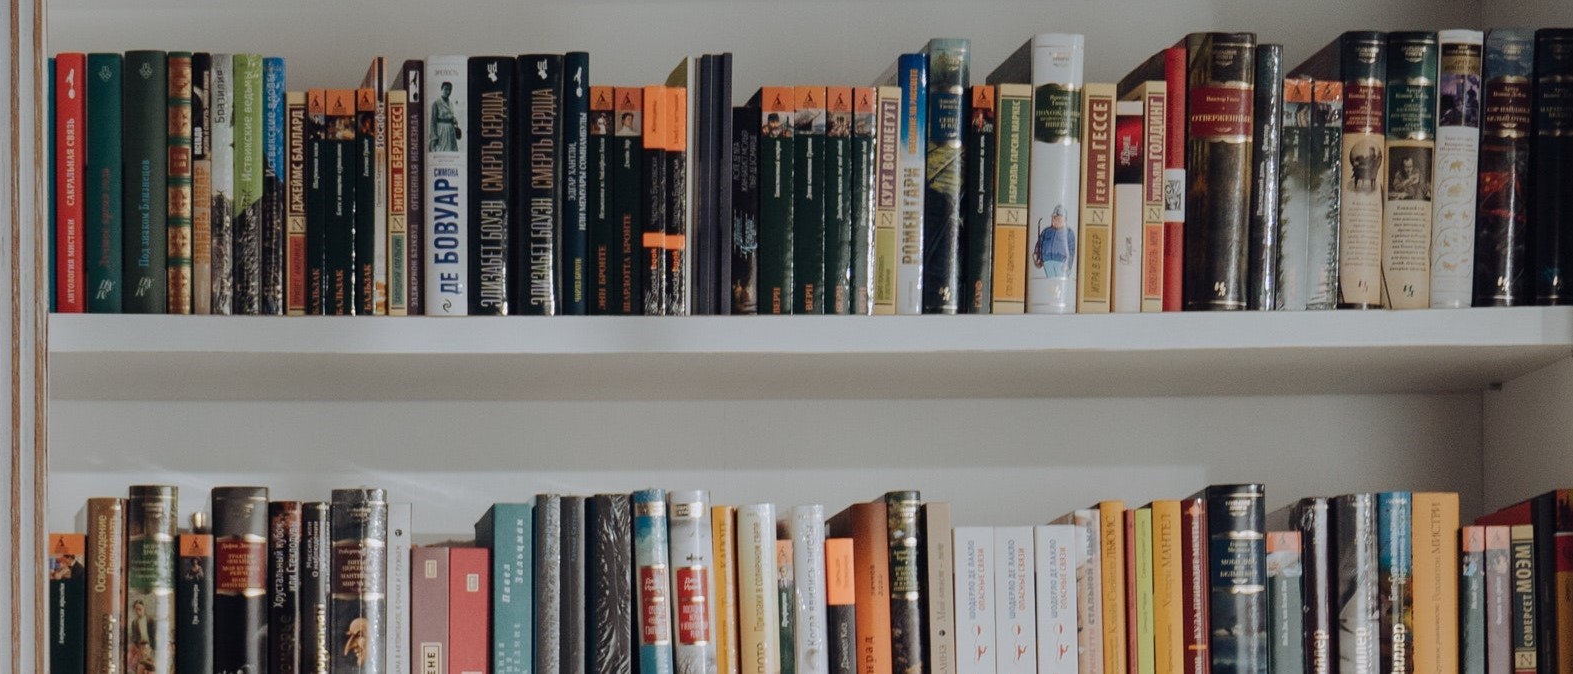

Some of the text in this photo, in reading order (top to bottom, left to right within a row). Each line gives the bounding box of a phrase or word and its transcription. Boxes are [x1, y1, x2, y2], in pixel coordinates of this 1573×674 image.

[66, 118, 75, 206] САКРАЛЬНАЯ СВЯЗЬ
[242, 71, 254, 181] Иствикские ведьмы
[266, 113, 277, 177] Иствикские
[291, 110, 305, 212] ДЖЕЙМС БАЛЛАРД
[411, 114, 419, 210] ОГНЕННАЯ НЕМЕЗИДА
[482, 91, 506, 192] СМЕРТЬ СЕРДЦА
[532, 89, 556, 189] СМЕРТЬ СЕРДЦА
[882, 103, 895, 206] КУРТ ВОННЕГУТ
[1009, 100, 1021, 203] ГАБРИЭЛЬ ГАРСИА МАРКЕС
[1092, 103, 1108, 201] ГЕРМАН ГЕССЕ
[1149, 98, 1163, 201] УИЛЬЯМ ГОЛДИНГ
[394, 174, 404, 211] ЭНТОНИ
[434, 179, 462, 294] ДЕ БОВУАР
[902, 167, 920, 265] РОМЕН ГАРИ
[67, 219, 75, 304] АНТОЛОГИЯ МИСТИКИ
[481, 200, 503, 307] ЭЛИЗАБЕТ БОУЭН
[531, 198, 553, 304] ЭЛИЗАБЕТ БОУЭН
[598, 245, 606, 284] БРОНТЕ
[623, 213, 631, 312] ШАРЛОТТА БРОНТЕ
[95, 515, 107, 592] Освобождение
[515, 519, 525, 584] Зальцман
[1105, 515, 1116, 560] ЛЬЮИС
[1160, 513, 1172, 568] МАНТЕЛ
[1430, 502, 1441, 554] МИСТРИ
[273, 550, 285, 608] Хрустальный
[502, 564, 511, 603] Павел
[754, 594, 764, 632] Призраки
[968, 570, 975, 578] ДЕ
[968, 581, 976, 620] ШОДЕРЛО
[1008, 569, 1016, 578] ДЕ
[1050, 569, 1057, 578] ДЕ
[1050, 580, 1058, 619] ШОДЕРЛО
[1085, 520, 1095, 625] СТАЛЬНОЙ АЛЬКОВ
[1191, 520, 1202, 640] КУДА ПРИВОДЯТ МЕЧТЫ
[1515, 545, 1534, 647] СОМЕРСЕТ МОЭМ
